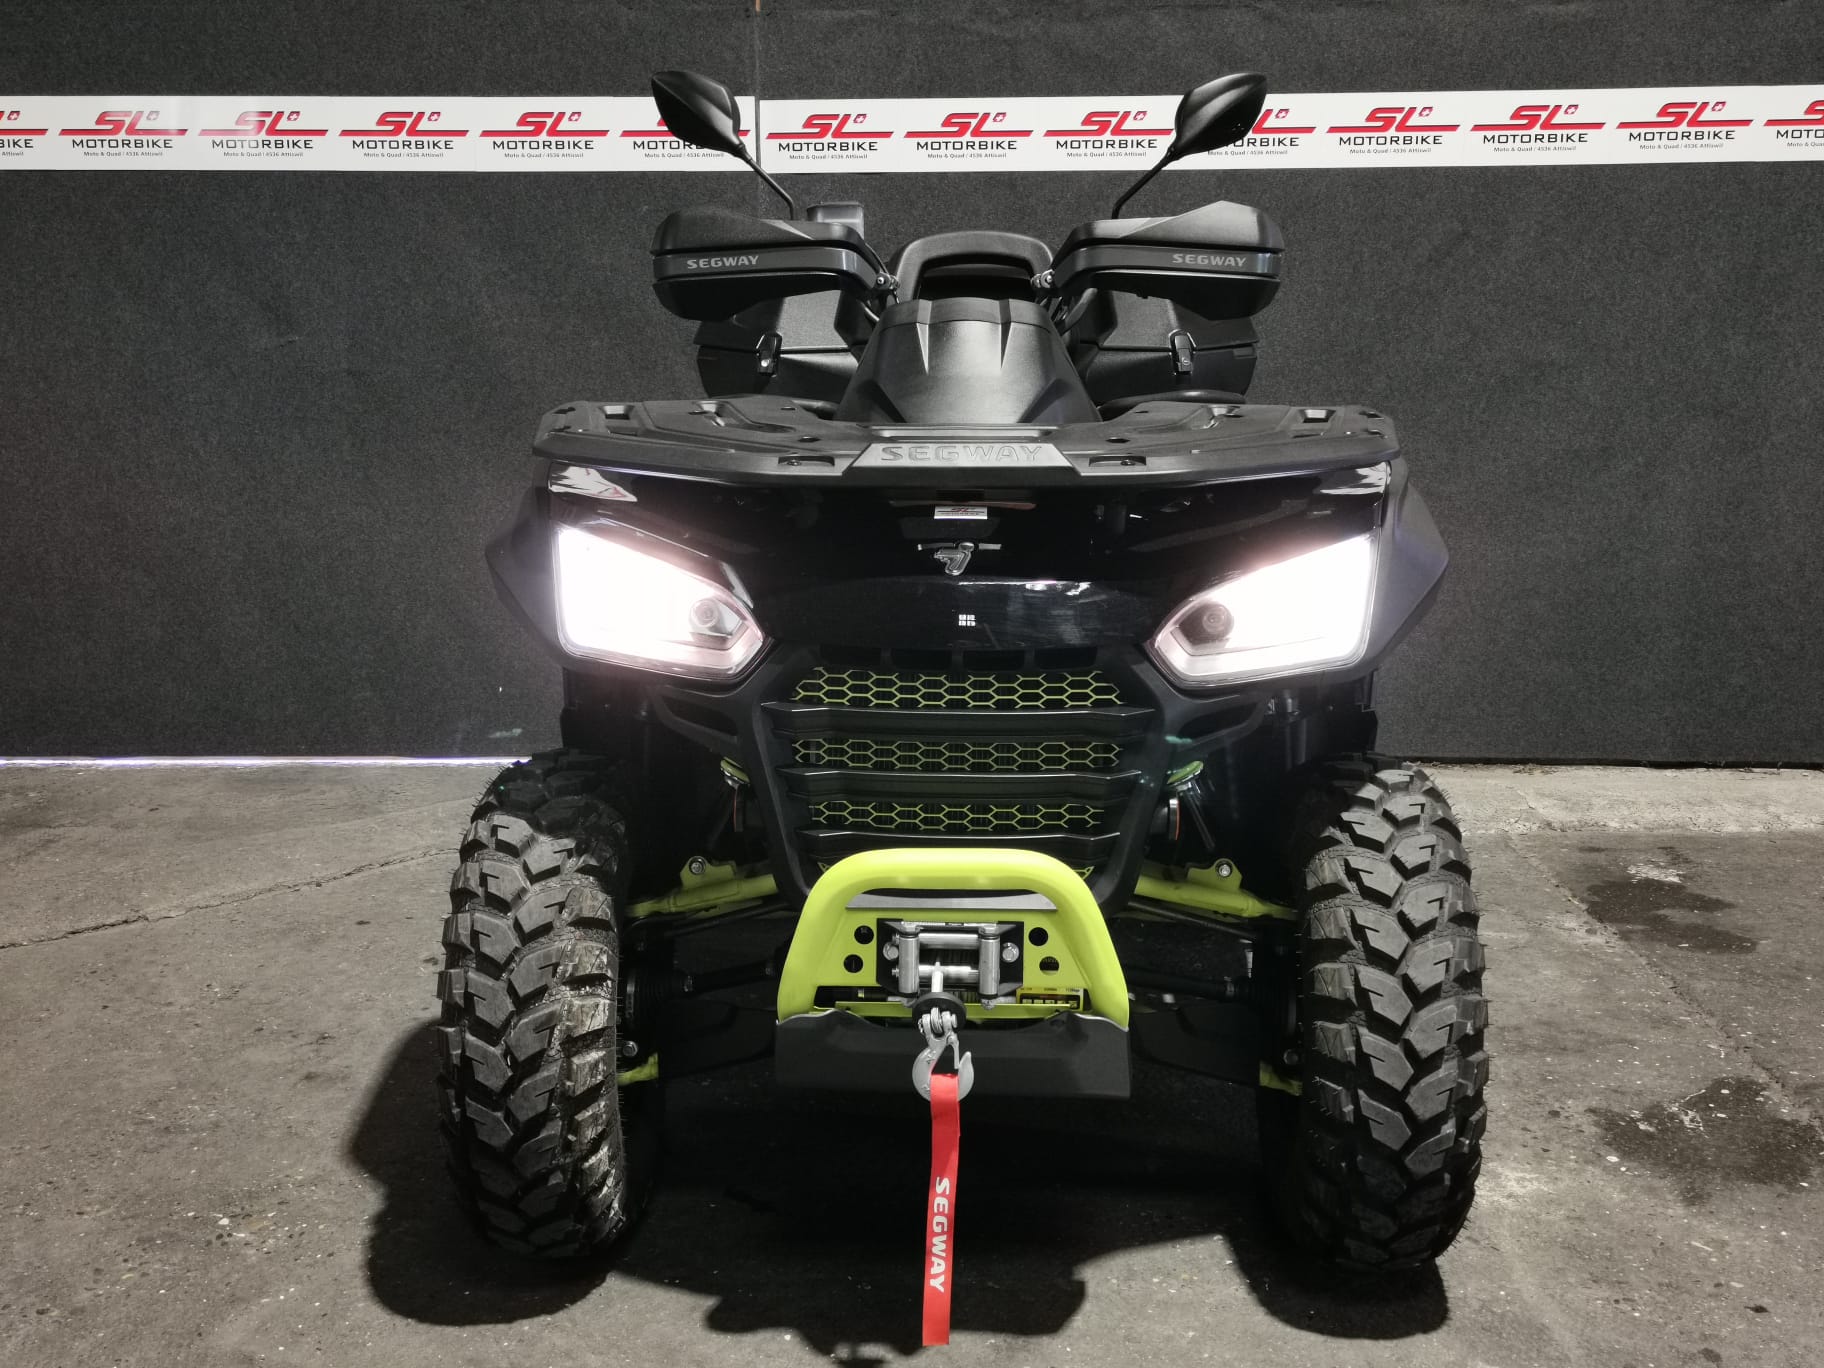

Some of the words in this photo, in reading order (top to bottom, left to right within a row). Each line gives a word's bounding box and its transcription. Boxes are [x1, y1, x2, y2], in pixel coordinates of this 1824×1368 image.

[1483, 133, 1588, 144] MOTORBIKE
[1629, 130, 1735, 141] MOTORBIKE
[72, 139, 172, 148] MOTORBIKE
[212, 140, 313, 149] MOTORBIKE
[353, 140, 453, 149] MOTORBIKE
[493, 140, 594, 150] MOTORBIKE
[917, 141, 1016, 150] MOTORBIKE
[1057, 139, 1157, 149] MOTORBIKE
[1339, 136, 1442, 146] MOTORBIKE
[779, 142, 878, 152] MOTORBIKE
[686, 255, 759, 269] SEGWAY
[1172, 253, 1247, 267] SEGWAY
[881, 445, 1042, 462] SEGWAY
[929, 1176, 950, 1293] SEGWAY
